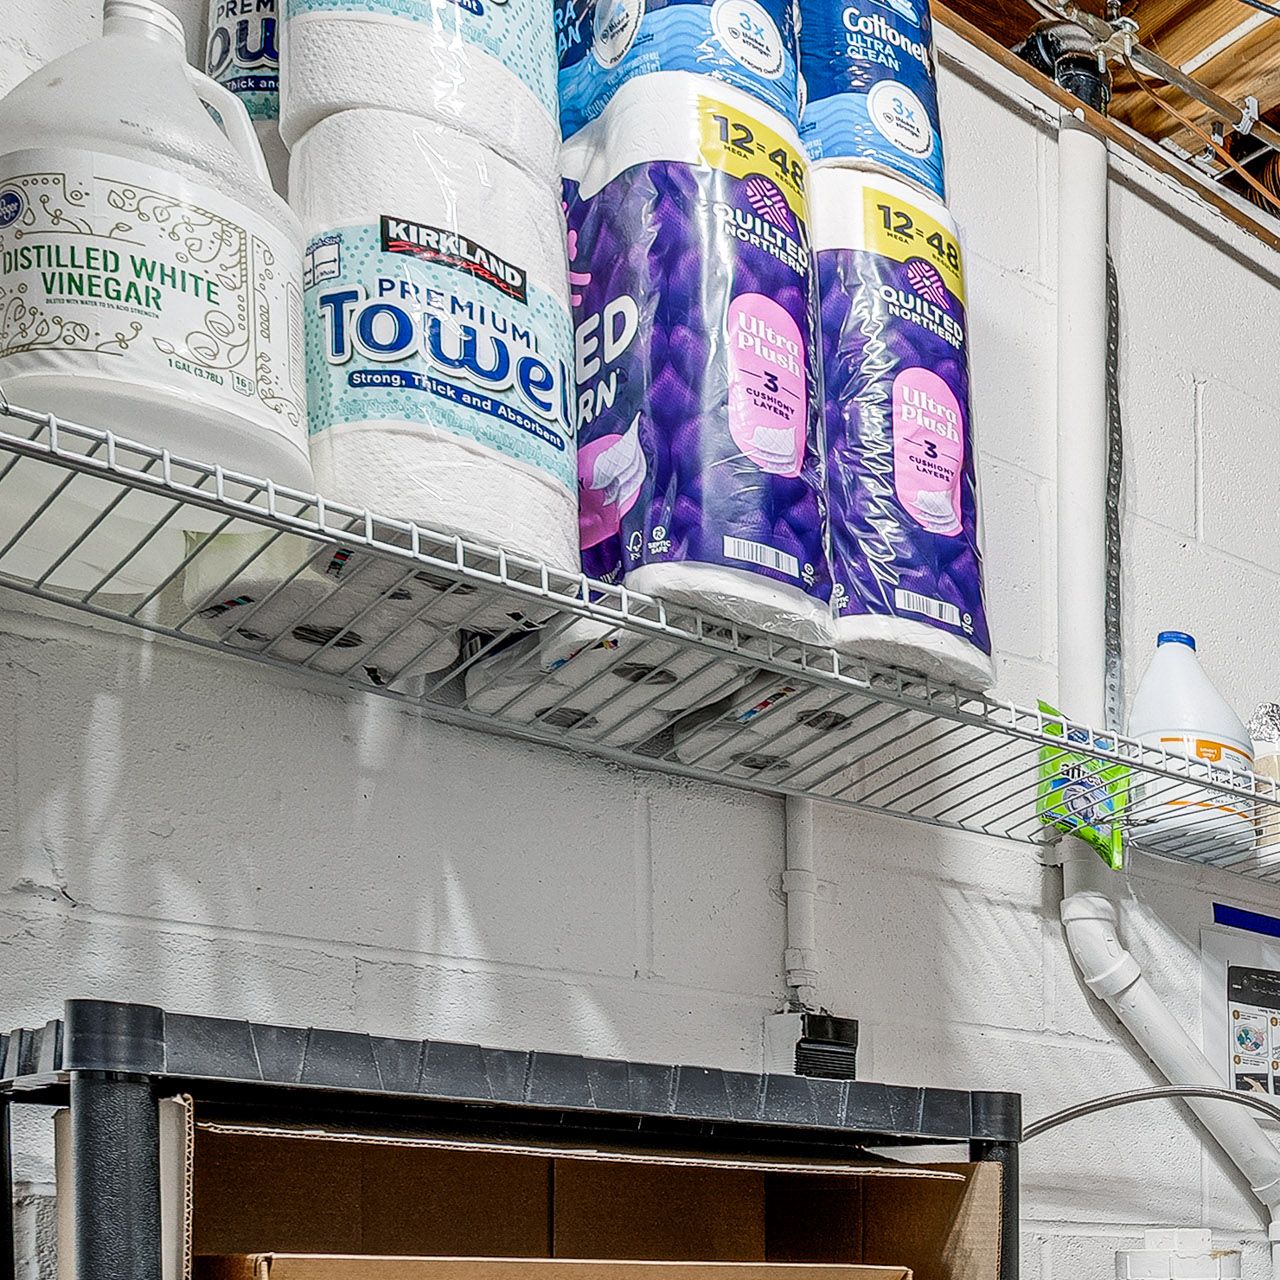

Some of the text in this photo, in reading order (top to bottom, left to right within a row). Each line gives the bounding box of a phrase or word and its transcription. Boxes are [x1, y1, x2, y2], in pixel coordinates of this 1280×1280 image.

[217, 0, 275, 24] PREM
[845, 32, 895, 58] ULTRA
[847, 45, 899, 72] CLEAN
[723, 145, 750, 161] MEGA
[388, 219, 523, 288] KIRKLAND
[713, 202, 810, 268] QUILTED
[724, 223, 806, 278] NORTHERN
[887, 231, 909, 245] MEGA
[3, 244, 221, 306] DISTILLED WHITE
[41, 271, 163, 312] VINEGAR
[378, 278, 532, 349] PREMIUM
[878, 285, 963, 342] QUILTED
[888, 304, 961, 351] NORTHERN
[737, 311, 800, 358] Ultra
[175, 360, 193, 375] GAL
[319, 287, 574, 437] Towel
[737, 333, 801, 378] Plush
[746, 388, 795, 414] CUSHIONY
[763, 370, 779, 393] 3
[352, 372, 564, 448] Strong, Thick and Absorbent
[753, 398, 791, 421] LAYERS
[900, 405, 960, 444] Plush
[901, 385, 958, 425] Ultra
[909, 455, 955, 477] CUSHIONY
[923, 440, 938, 459] 3
[916, 465, 951, 483] LAYERS
